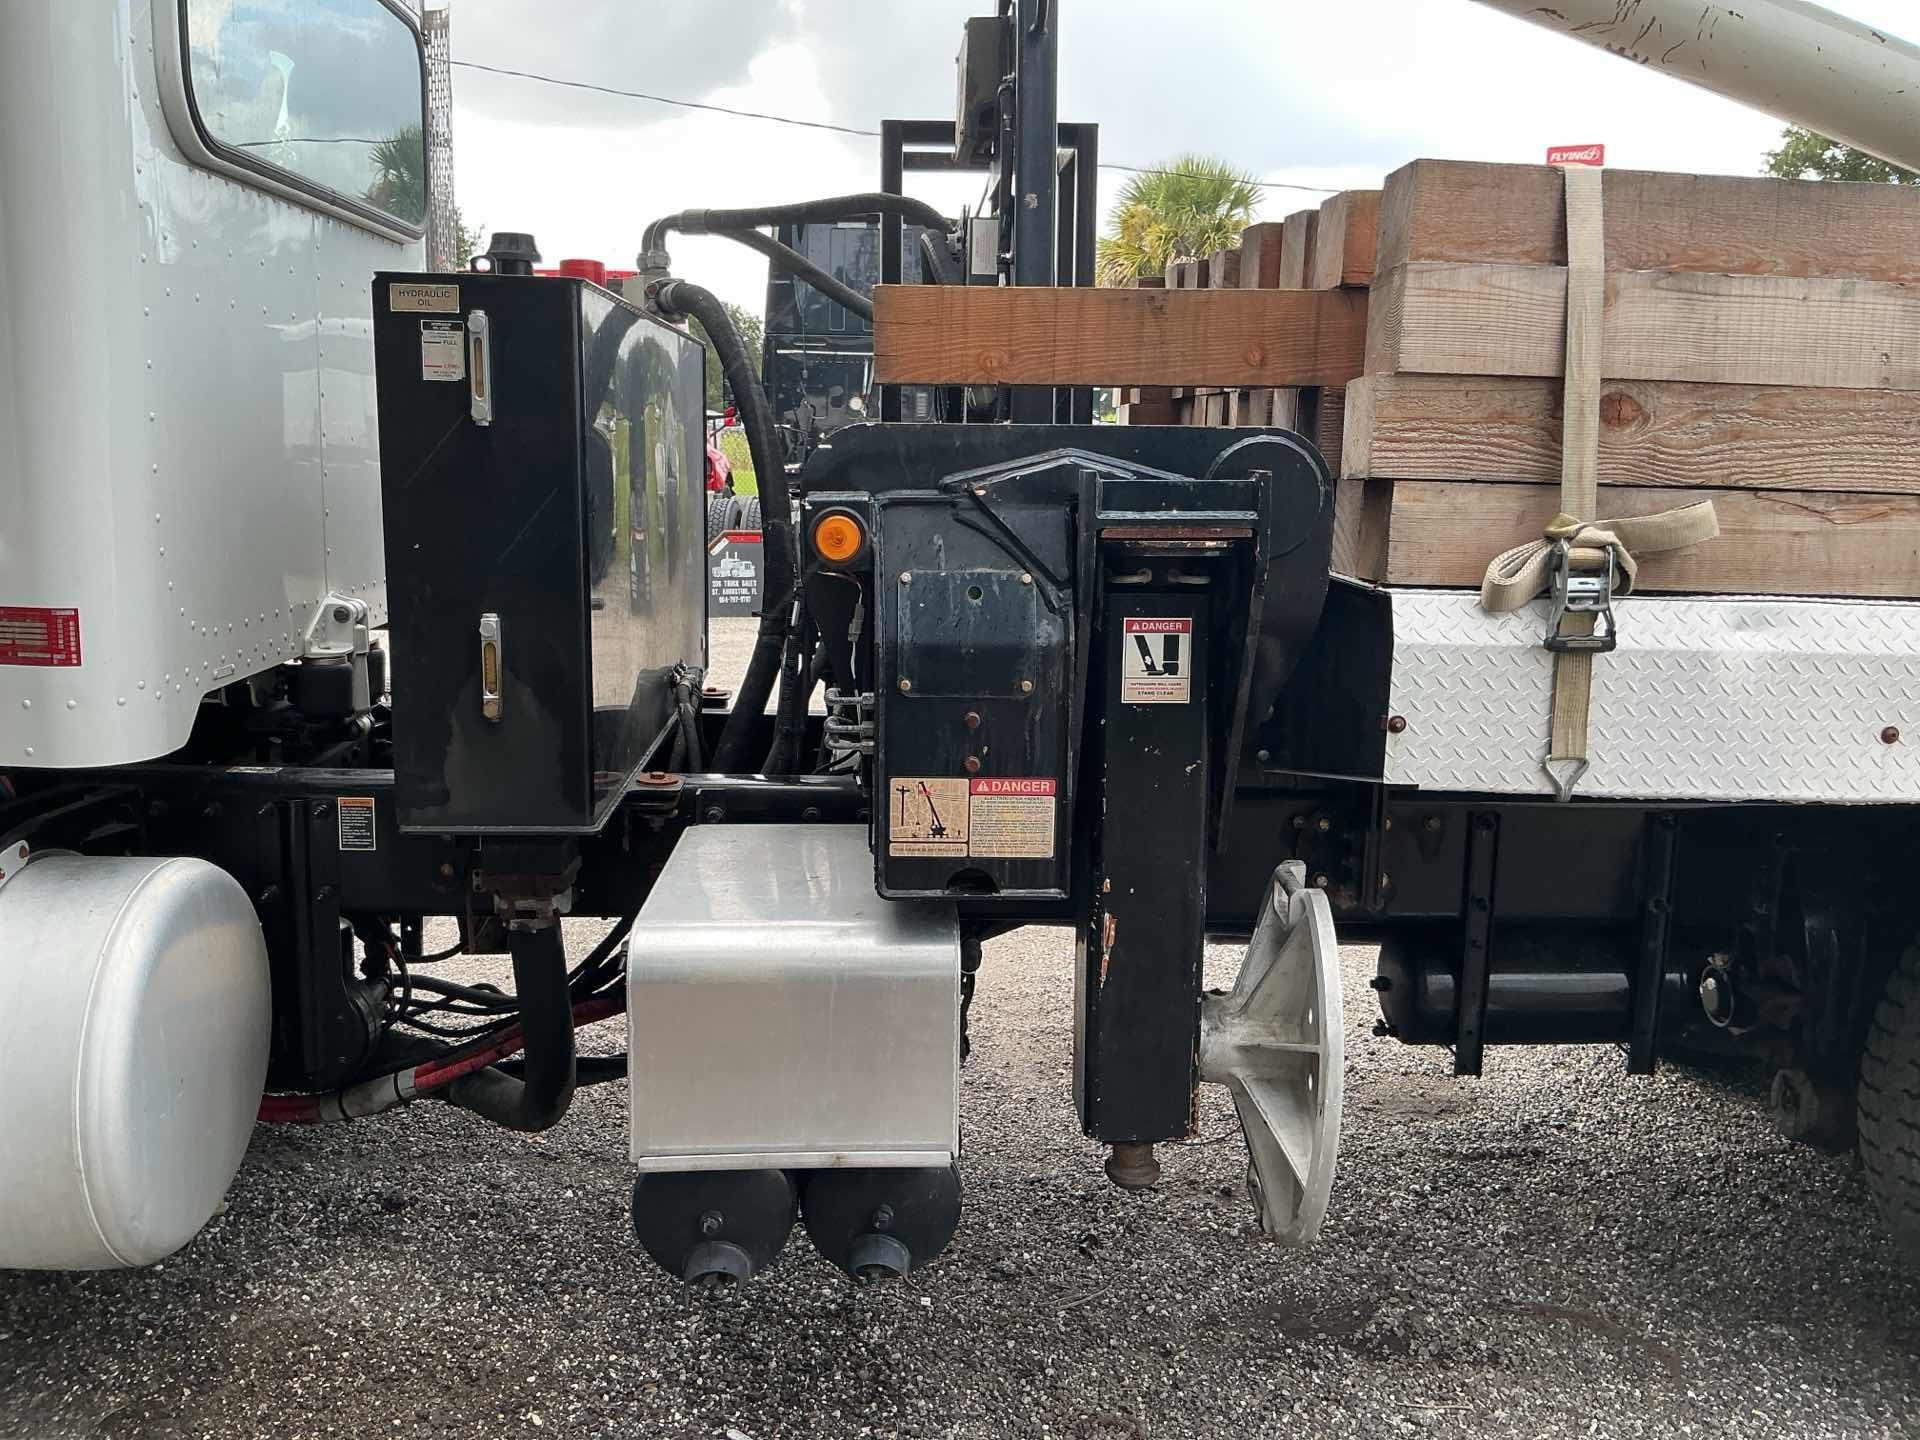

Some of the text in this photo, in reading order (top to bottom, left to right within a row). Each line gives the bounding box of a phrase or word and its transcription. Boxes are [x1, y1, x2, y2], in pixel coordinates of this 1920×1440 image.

[1550, 151, 1590, 162] FLYING
[398, 289, 450, 298] HYDRAULIC
[417, 298, 433, 307] OIL
[1141, 622, 1183, 631] DANGER
[991, 781, 1050, 793] DANGER
